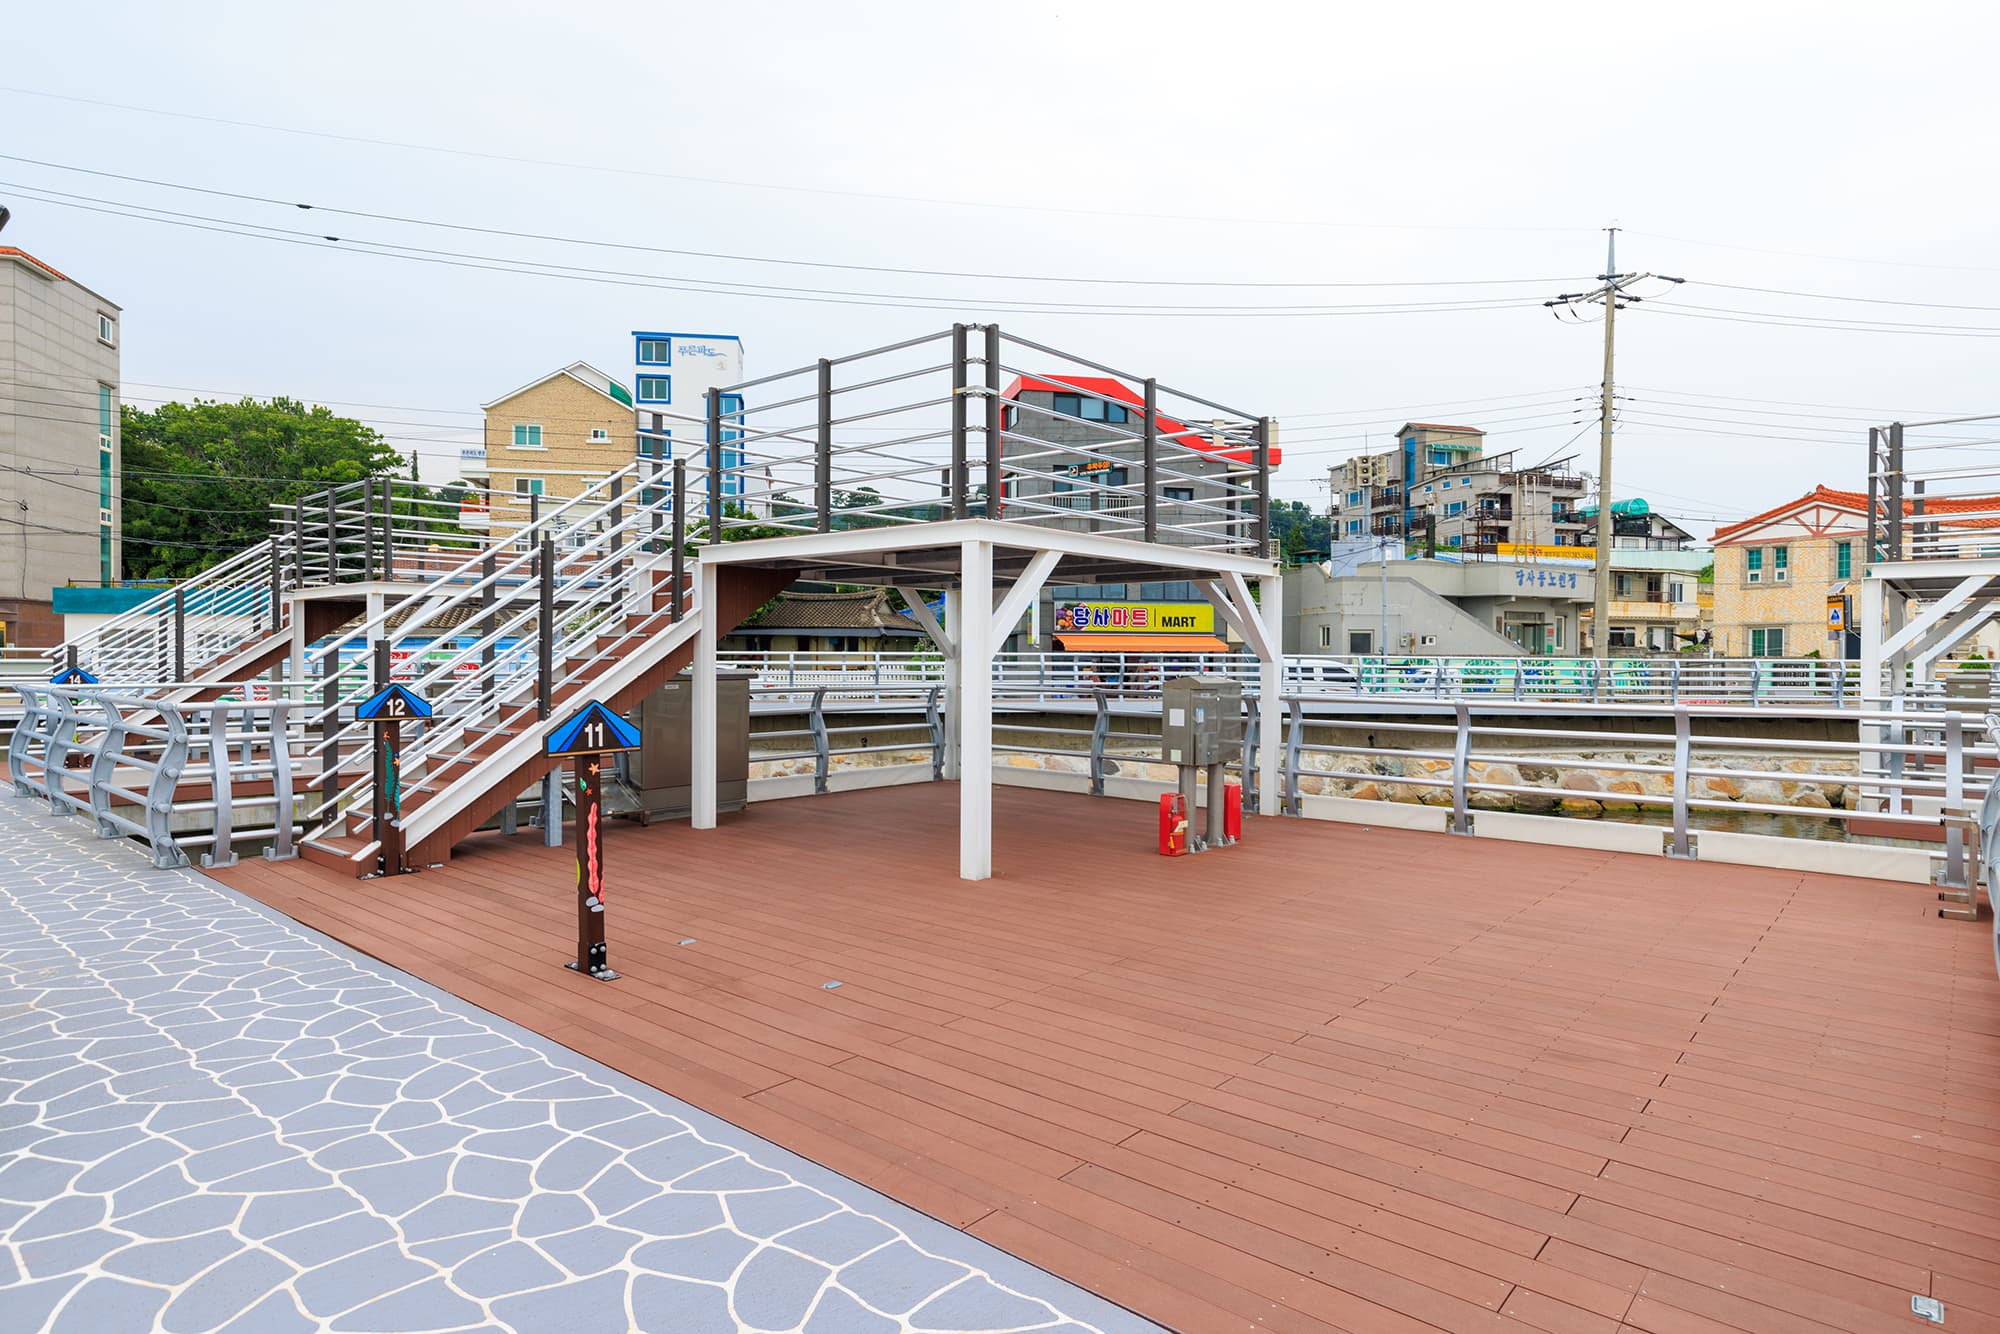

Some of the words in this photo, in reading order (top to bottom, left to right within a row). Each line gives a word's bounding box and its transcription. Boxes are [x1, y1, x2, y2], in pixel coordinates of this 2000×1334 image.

[1515, 568, 1577, 589] 당사동노인정
[1073, 606, 1148, 627] 당사마트
[1161, 616, 1196, 628] MART
[69, 674, 81, 684] 14
[386, 698, 405, 717] 12
[584, 722, 604, 748] 11
